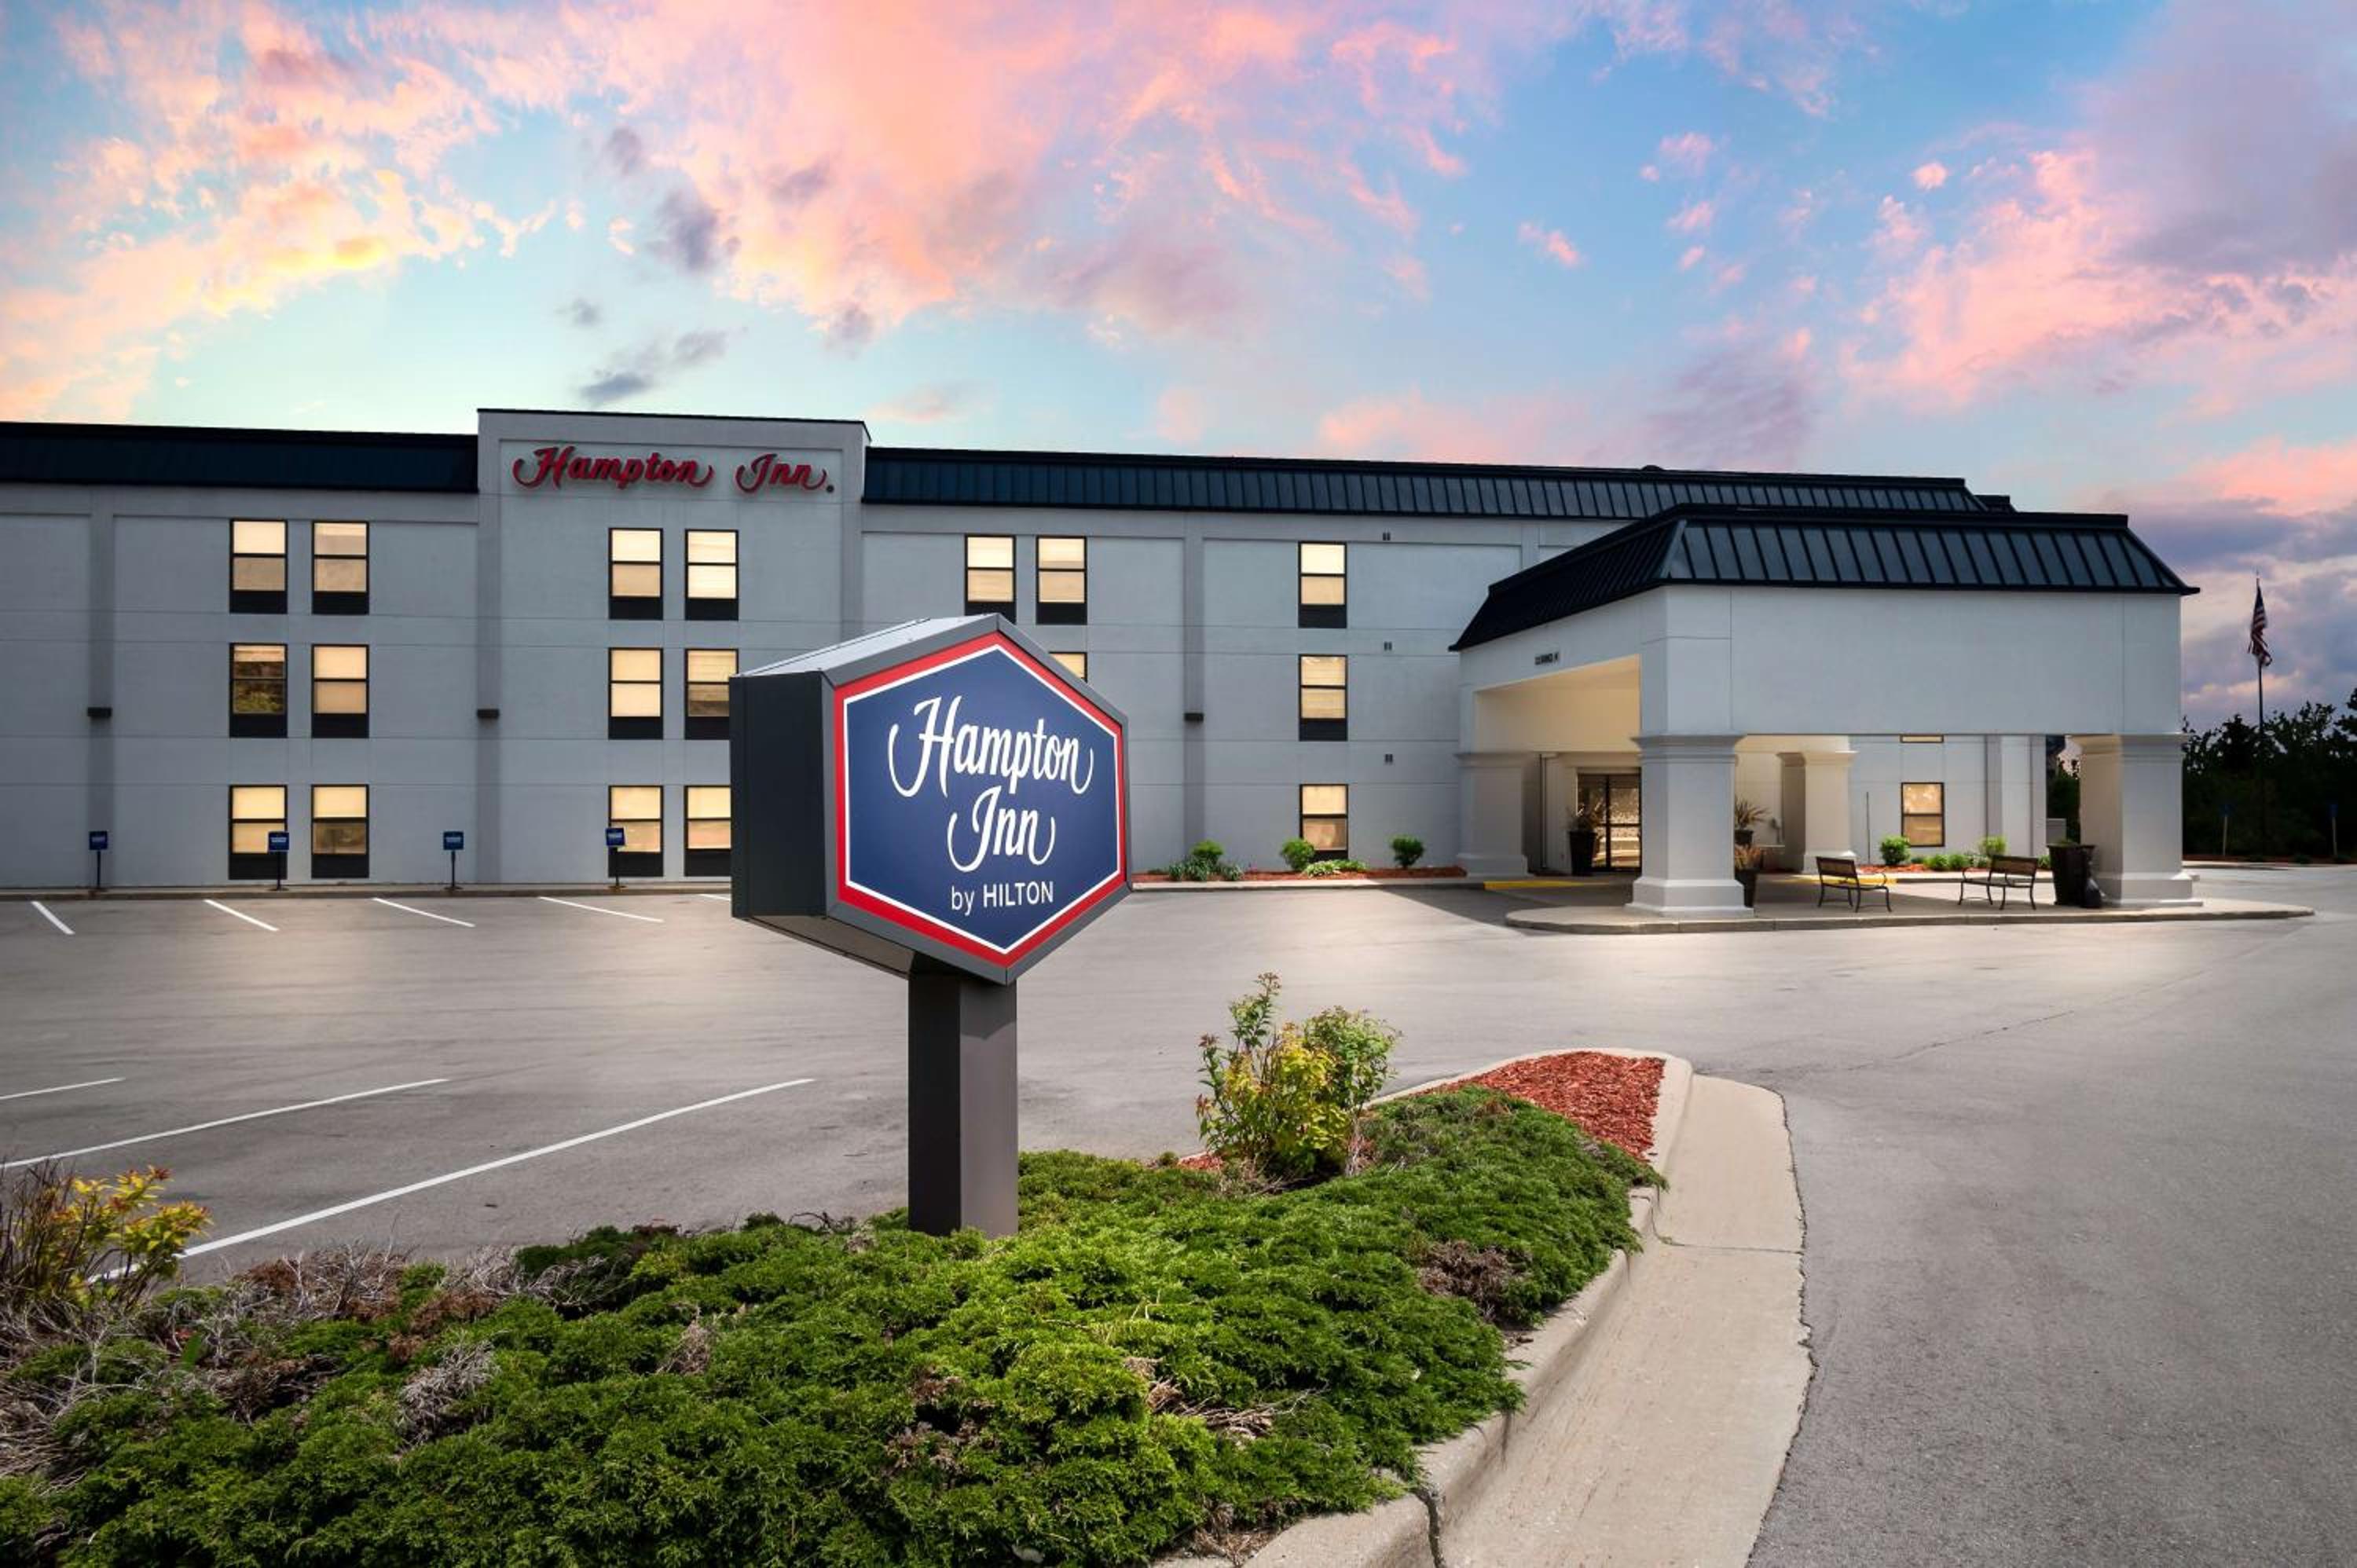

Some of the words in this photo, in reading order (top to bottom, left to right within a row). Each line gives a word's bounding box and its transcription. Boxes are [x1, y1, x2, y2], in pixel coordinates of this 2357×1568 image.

[512, 445, 714, 489] Hampton
[735, 453, 828, 493] Inn
[888, 695, 1094, 797] Hampton
[947, 786, 1055, 872] Inn
[951, 886, 975, 915] by
[983, 881, 1054, 907] HILTON
